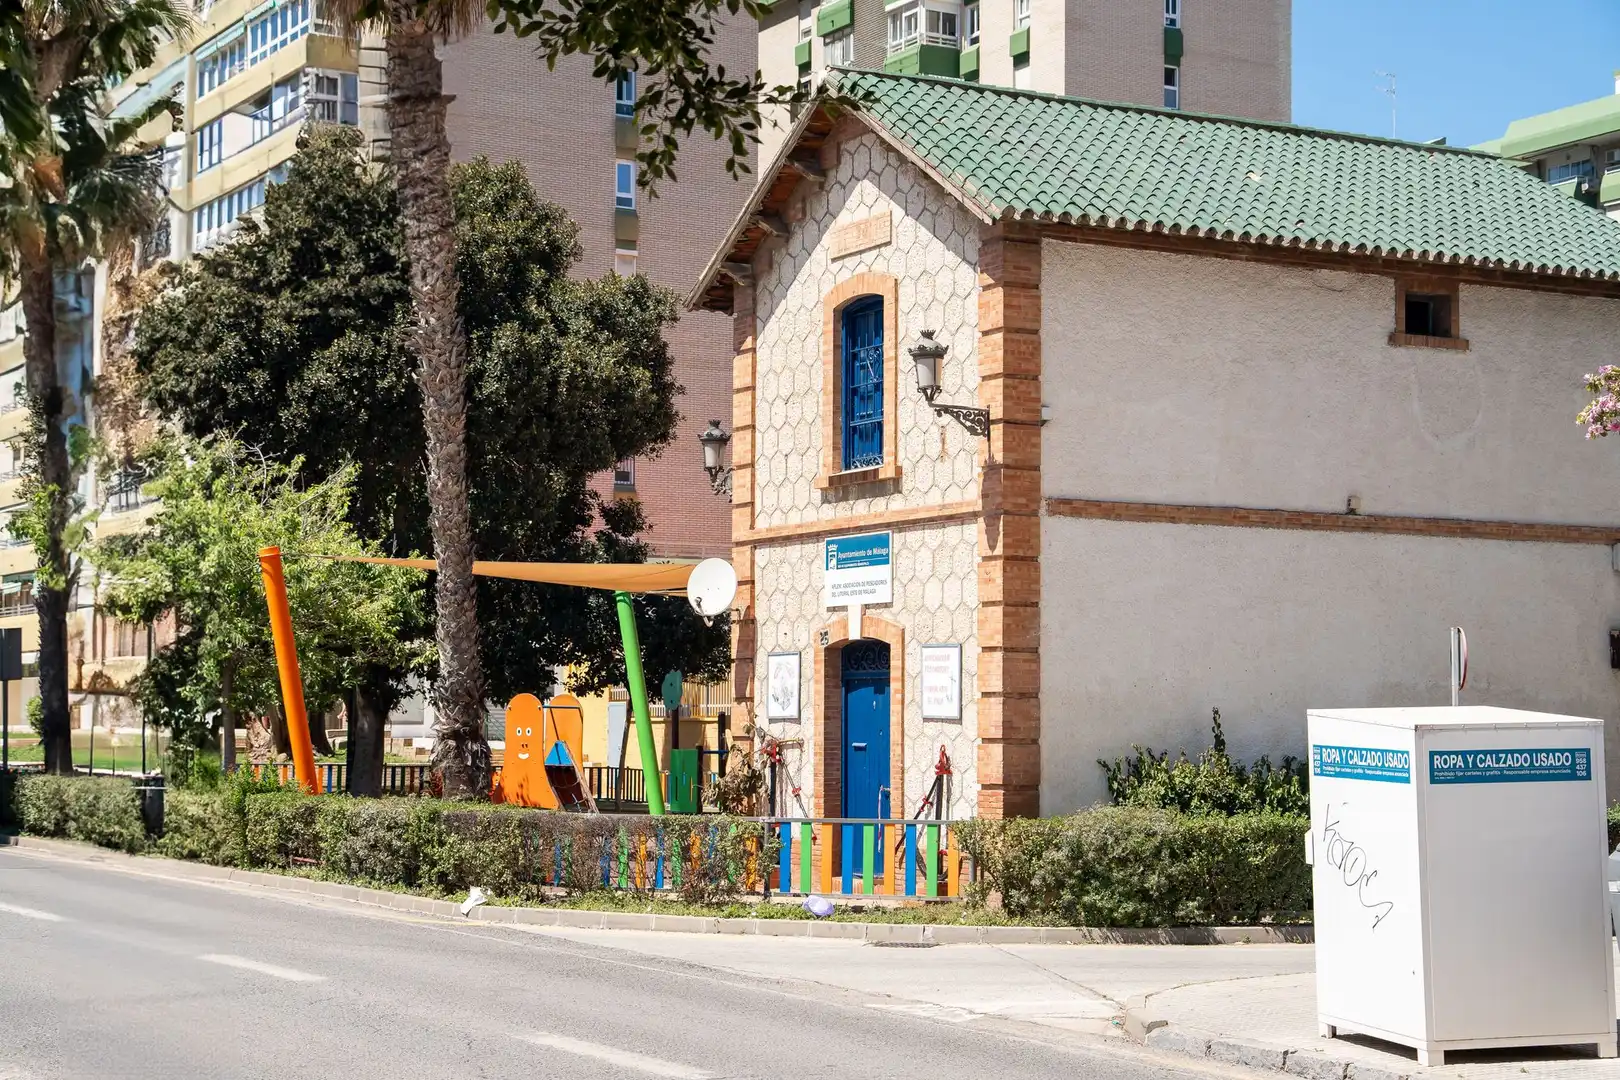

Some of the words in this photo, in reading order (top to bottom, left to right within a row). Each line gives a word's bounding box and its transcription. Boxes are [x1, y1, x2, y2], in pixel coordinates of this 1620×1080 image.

[838, 551, 866, 561] Ayuntamiento
[873, 547, 889, 556] Málaga
[1321, 747, 1341, 764] ROPA
[1341, 749, 1347, 764] Y
[1347, 749, 1383, 767] CALZADO
[1383, 752, 1409, 769] USADO
[1433, 754, 1464, 769] ROPA
[1466, 754, 1474, 768] Y
[1476, 753, 1531, 768] CALZADO
[1532, 752, 1572, 767] USADO
